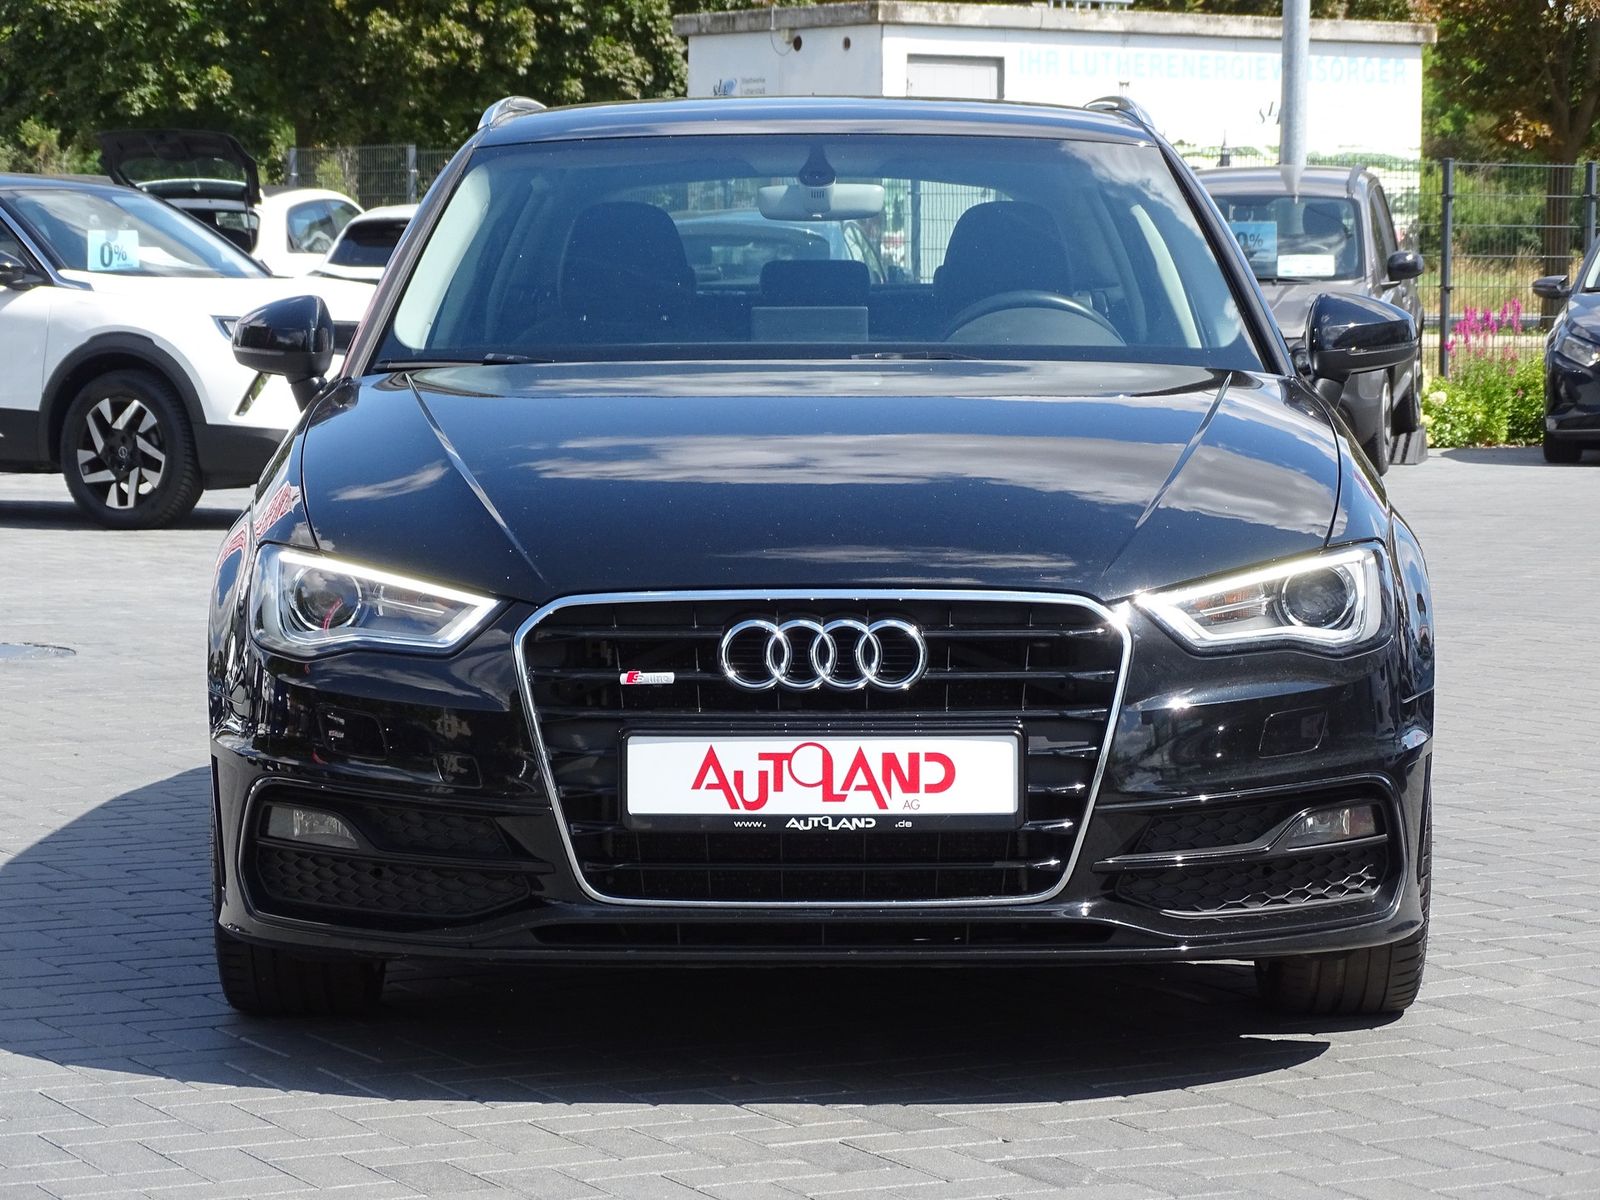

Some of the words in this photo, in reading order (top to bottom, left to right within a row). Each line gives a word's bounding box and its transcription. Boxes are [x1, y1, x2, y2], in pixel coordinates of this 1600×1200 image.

[1018, 49, 1059, 76] IHR
[1069, 51, 1408, 84] LUTHERENERGIEVSORGER
[100, 241, 128, 268] 0%
[902, 799, 921, 810] AG
